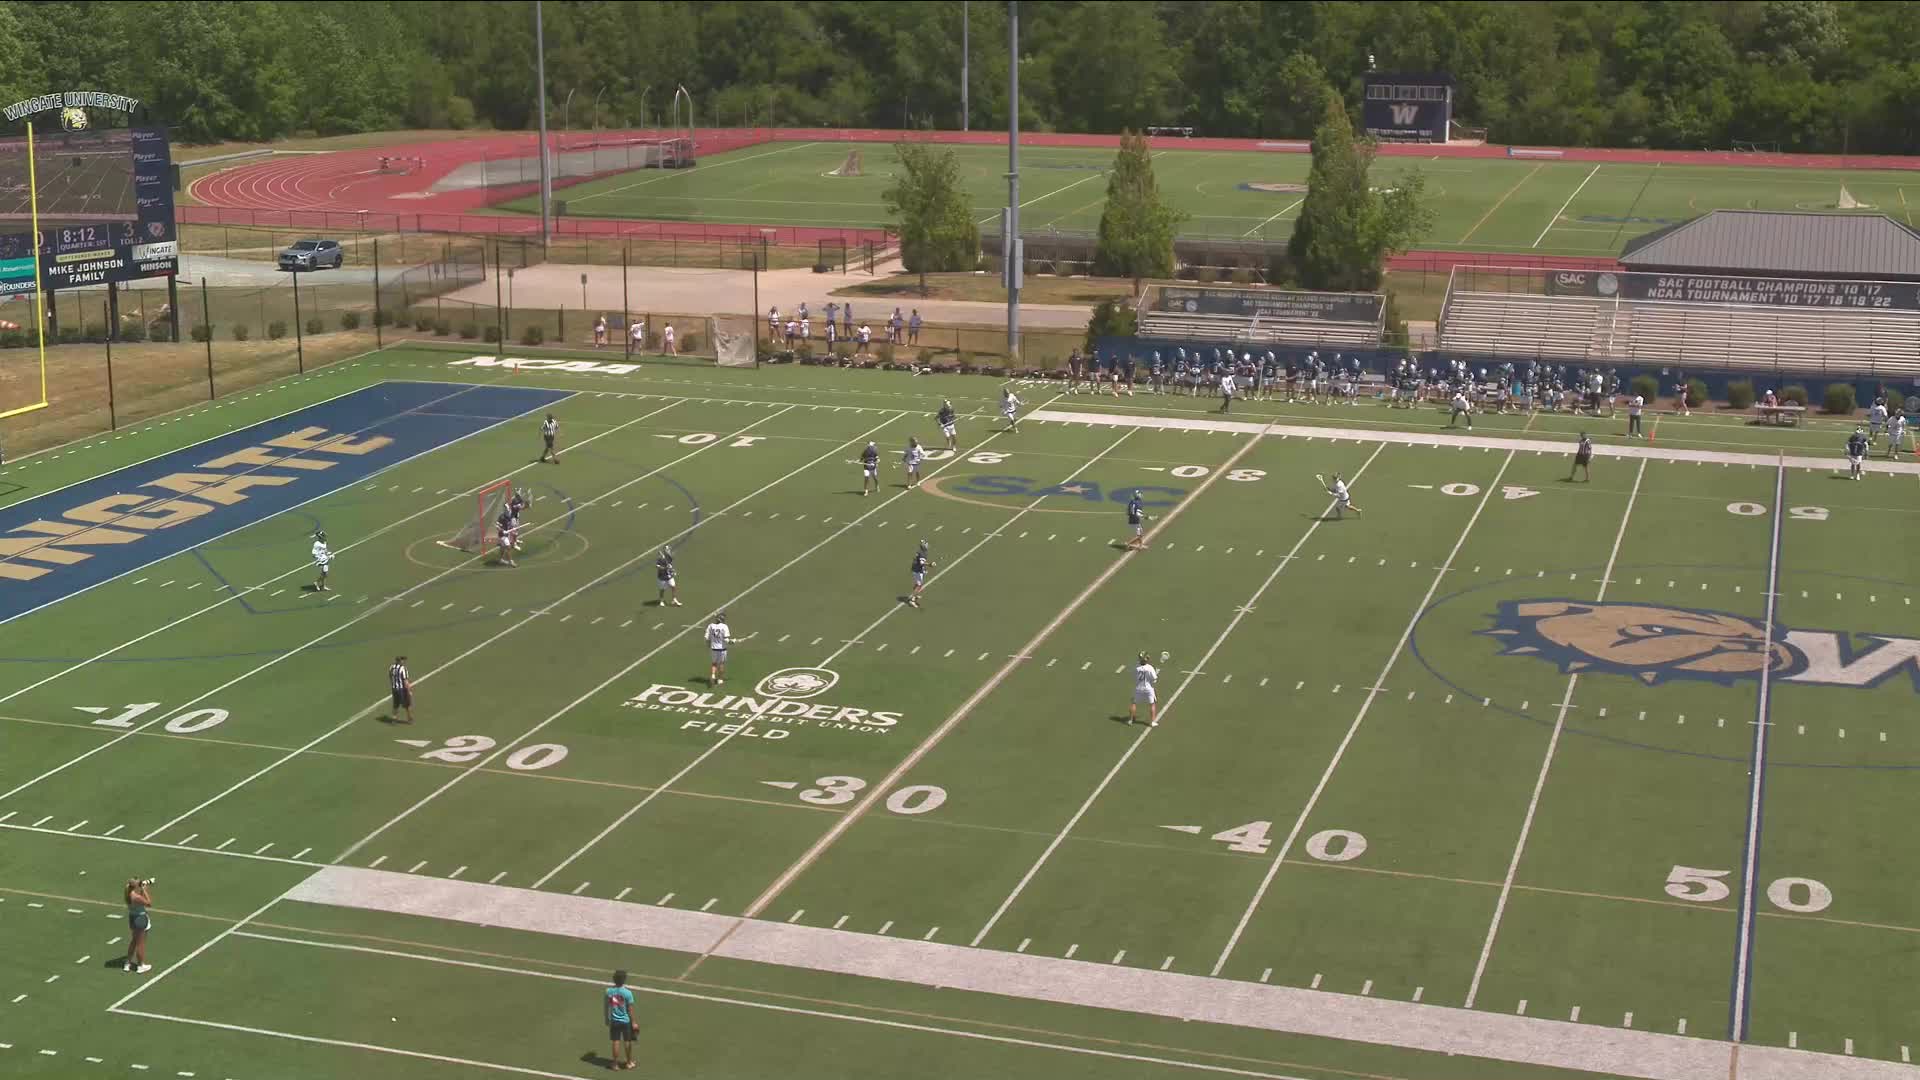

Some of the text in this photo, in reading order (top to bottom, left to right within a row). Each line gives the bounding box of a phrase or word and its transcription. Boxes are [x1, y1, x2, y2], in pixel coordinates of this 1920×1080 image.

[3, 91, 139, 121] WINGATE UNIVERSITY
[1391, 103, 1419, 125] W
[63, 227, 95, 243] 8:12
[49, 264, 74, 276] MIKE
[77, 259, 124, 273] JOHNSON
[140, 261, 172, 272] HINSON
[3, 280, 36, 292] FOUNDERS
[69, 271, 105, 284] FAMILY
[1560, 273, 1586, 285] SAC
[1658, 277, 1882, 295] SAC FOOTBALL CHAMPIONS '10 '17
[1648, 288, 1682, 299] NCAA
[1687, 289, 1776, 302] TOURNAMENT
[1780, 293, 1798, 304] '10
[1802, 294, 1821, 305] '17
[1871, 296, 1892, 307] '22
[448, 356, 642, 374] NCAA
[953, 475, 1188, 507] SAC
[629, 683, 904, 727] FOUNDERS
[619, 701, 889, 735] FEDERAL CREDIT UNION
[680, 720, 790, 740] FIELD
